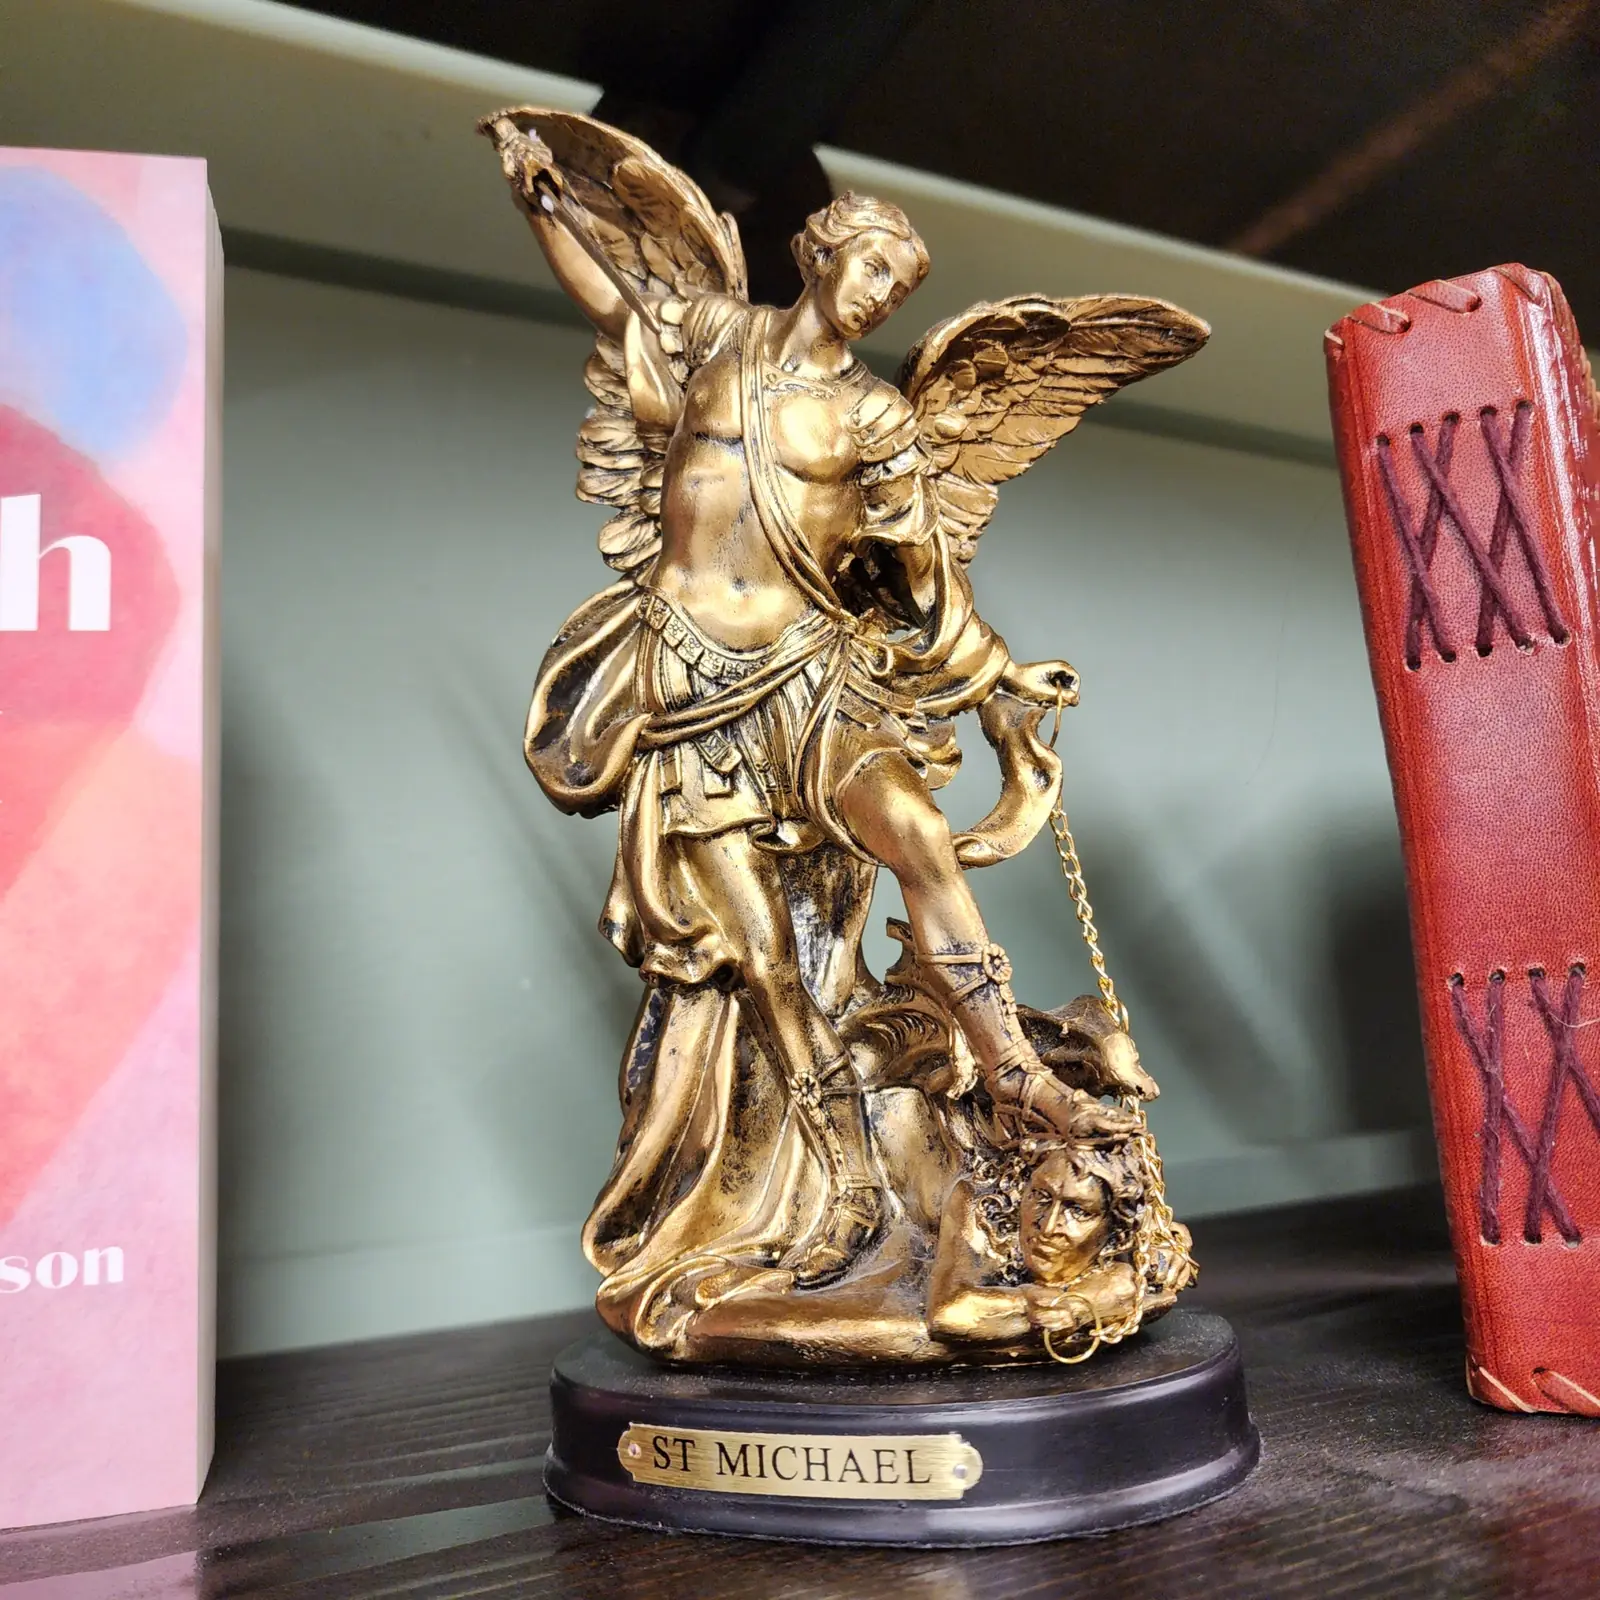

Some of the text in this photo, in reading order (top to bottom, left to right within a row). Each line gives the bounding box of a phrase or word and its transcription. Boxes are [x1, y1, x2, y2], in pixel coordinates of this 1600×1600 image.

[0, 1246, 124, 1294] son
[652, 1435, 931, 1484] ST MICHAEL
